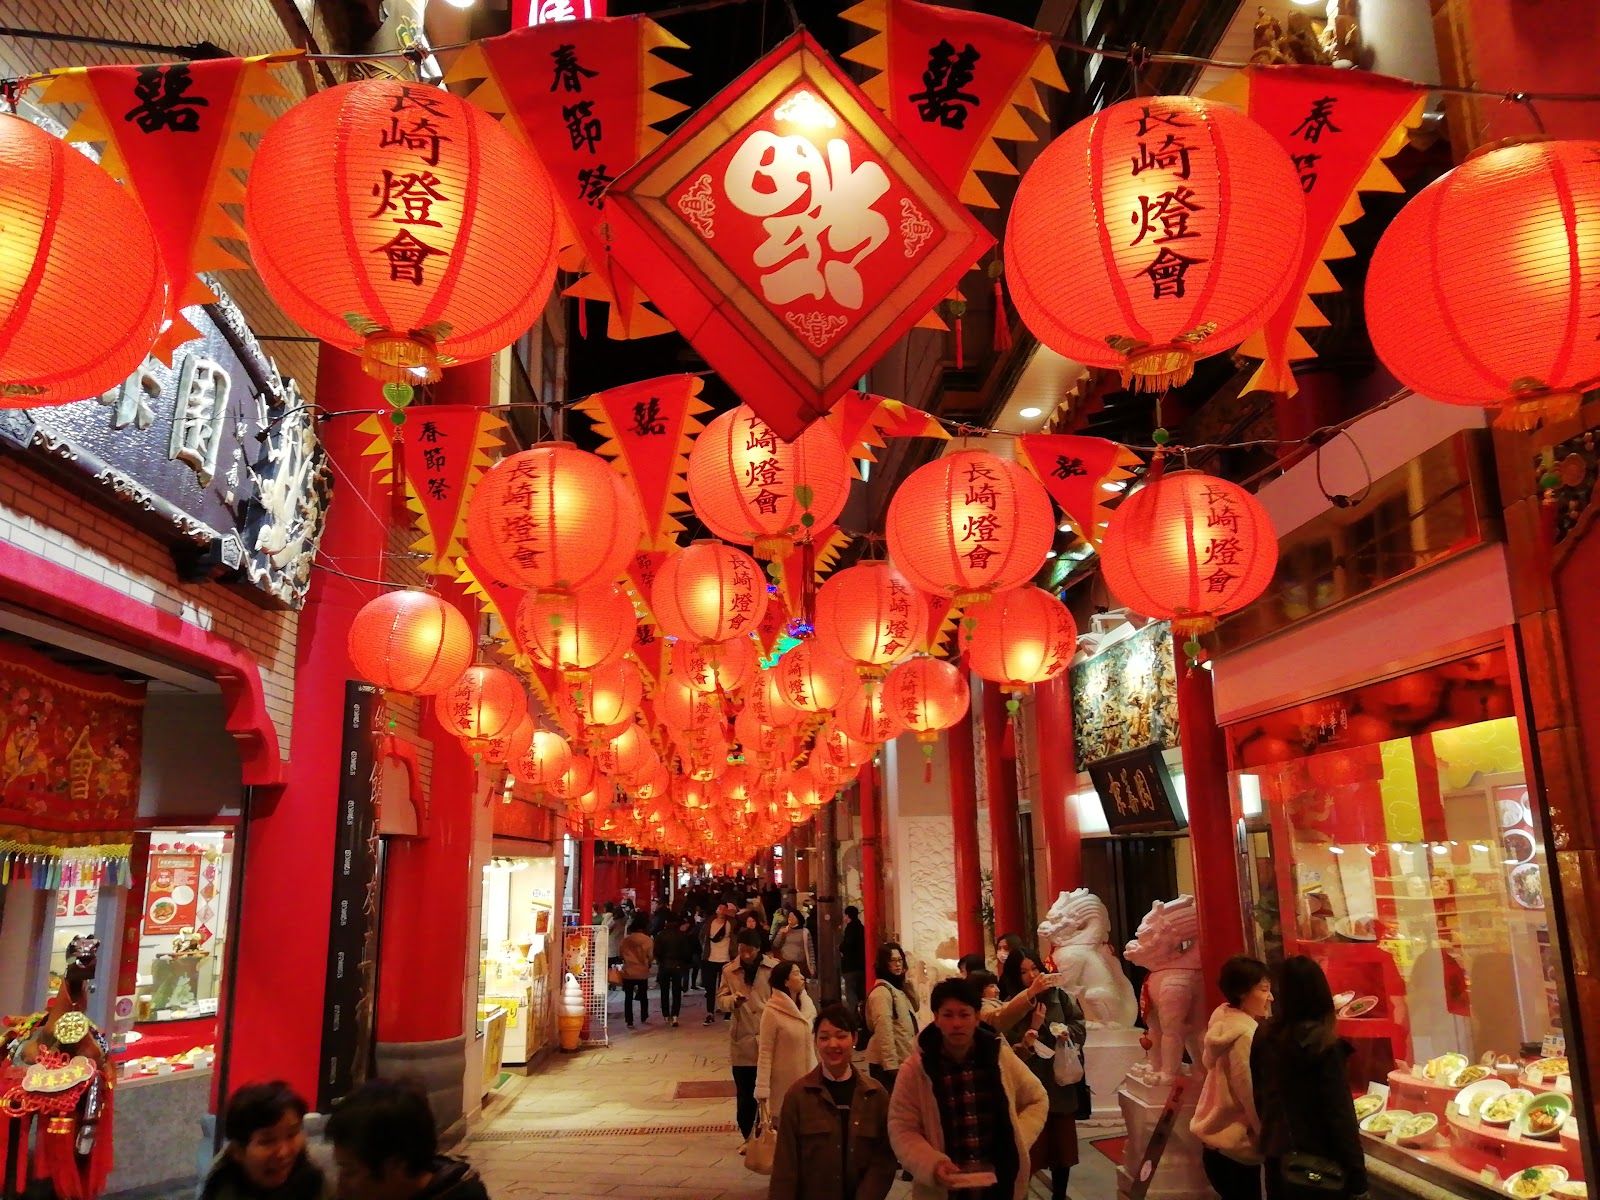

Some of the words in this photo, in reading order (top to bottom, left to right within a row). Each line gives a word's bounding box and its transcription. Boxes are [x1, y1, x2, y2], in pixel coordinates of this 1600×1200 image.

[550, 44, 616, 210] 春節祭
[369, 86, 453, 286] 長崎燈會
[723, 130, 891, 310] 福
[1126, 106, 1208, 299] 長崎燈會
[417, 421, 450, 500] 春節祭
[502, 459, 541, 570] 長崎燈會
[961, 462, 1001, 569] 長崎燈會
[728, 554, 753, 630] 長崎燈會
[1199, 484, 1243, 593] 長崎燈會
[880, 578, 912, 656] 長崎燈會
